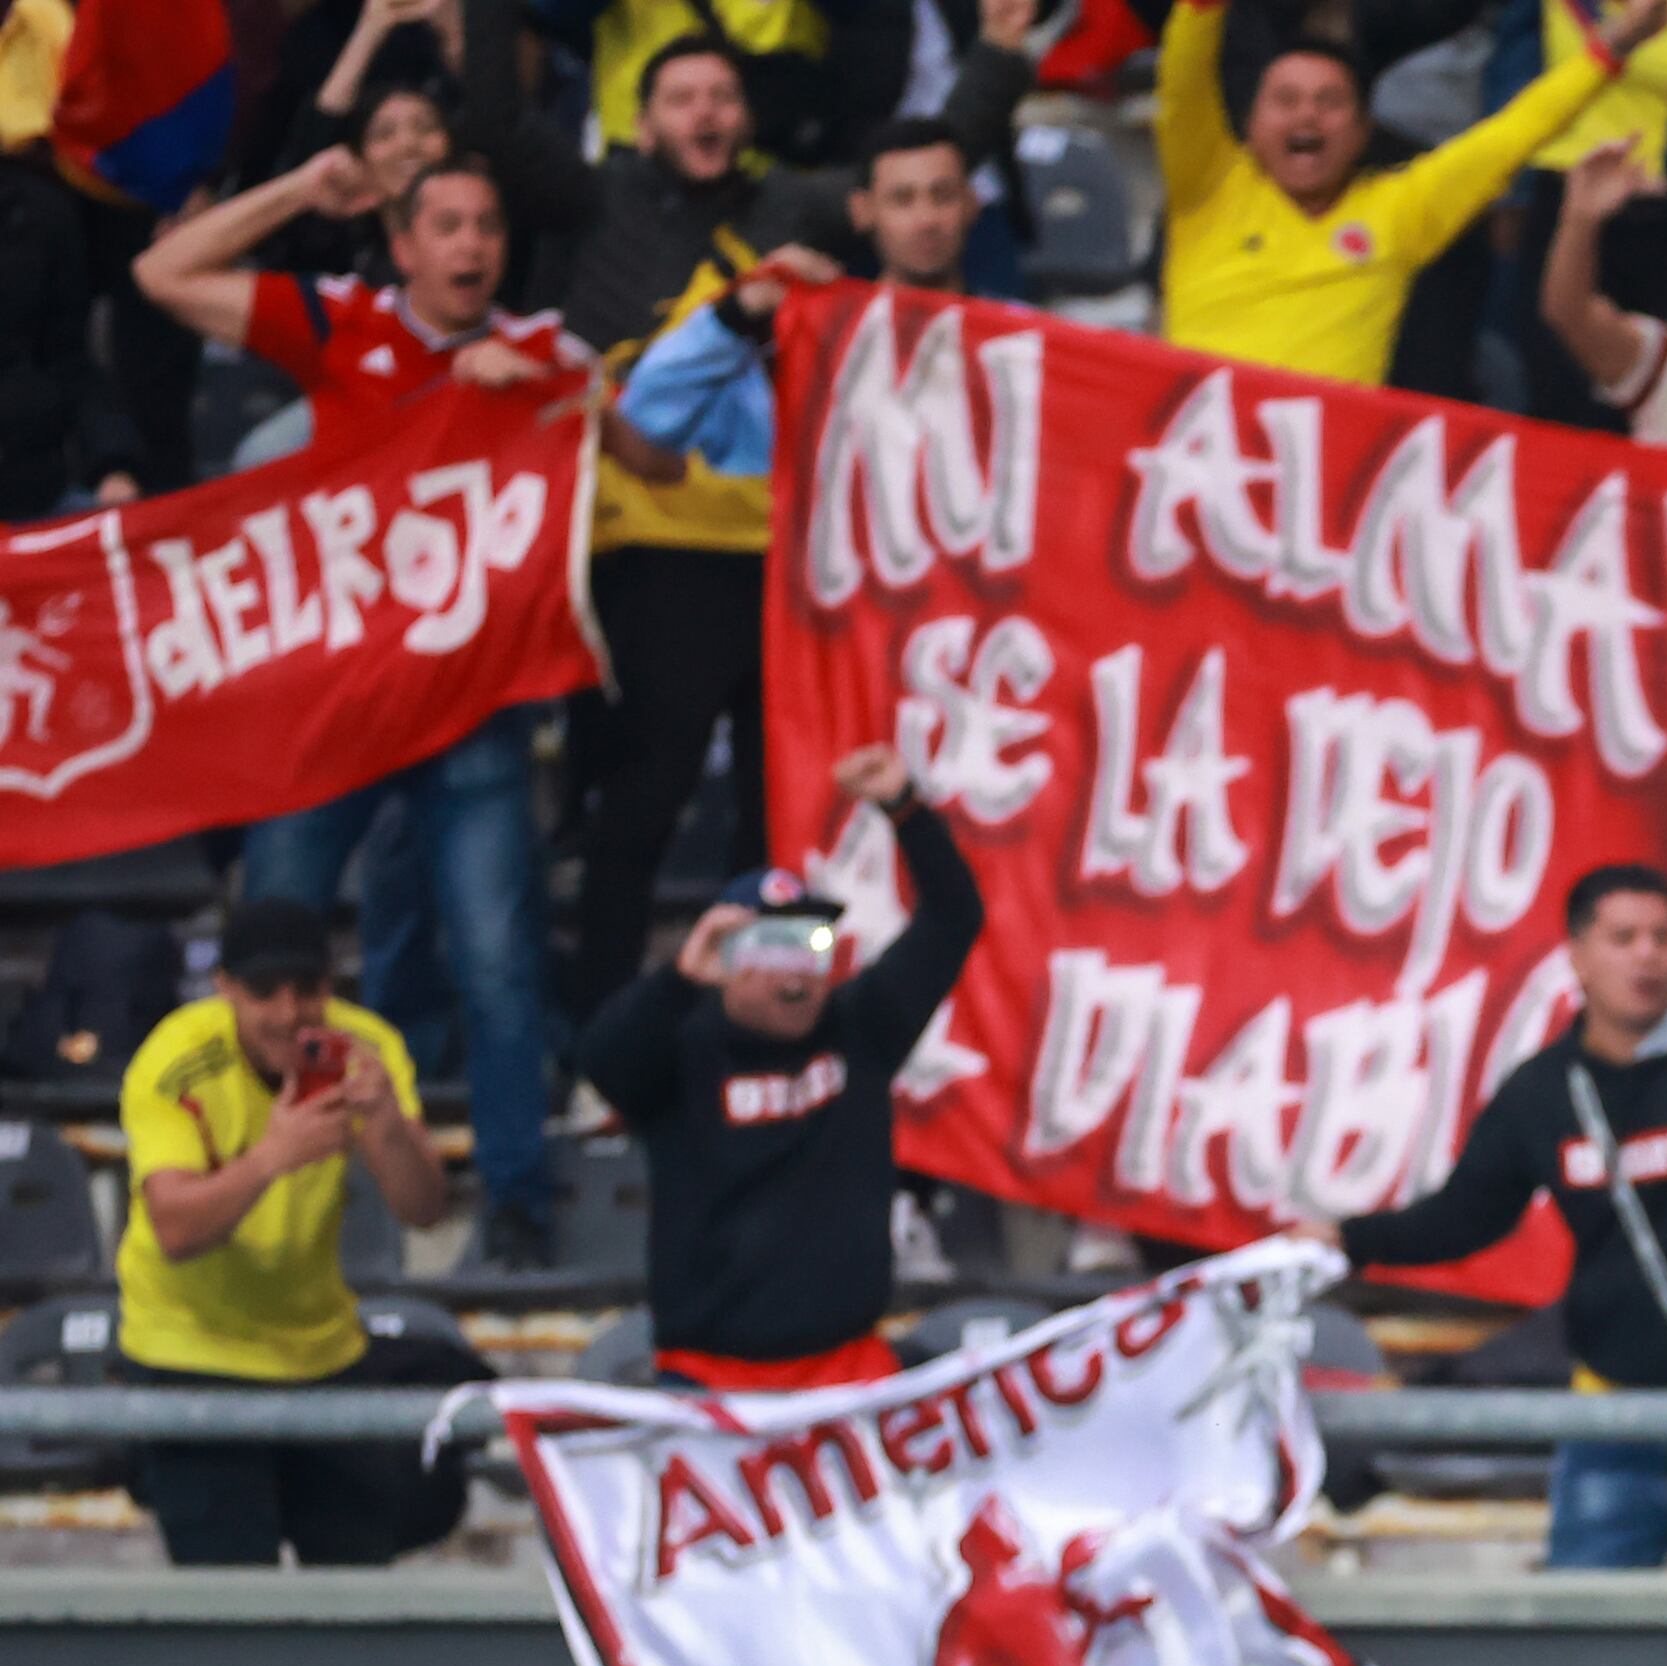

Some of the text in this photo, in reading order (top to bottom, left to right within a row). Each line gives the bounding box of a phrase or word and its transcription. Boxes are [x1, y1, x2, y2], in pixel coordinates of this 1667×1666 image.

[808, 286, 1044, 608] MI
[896, 616, 1053, 824] SE
[1082, 645, 1250, 897] LA
